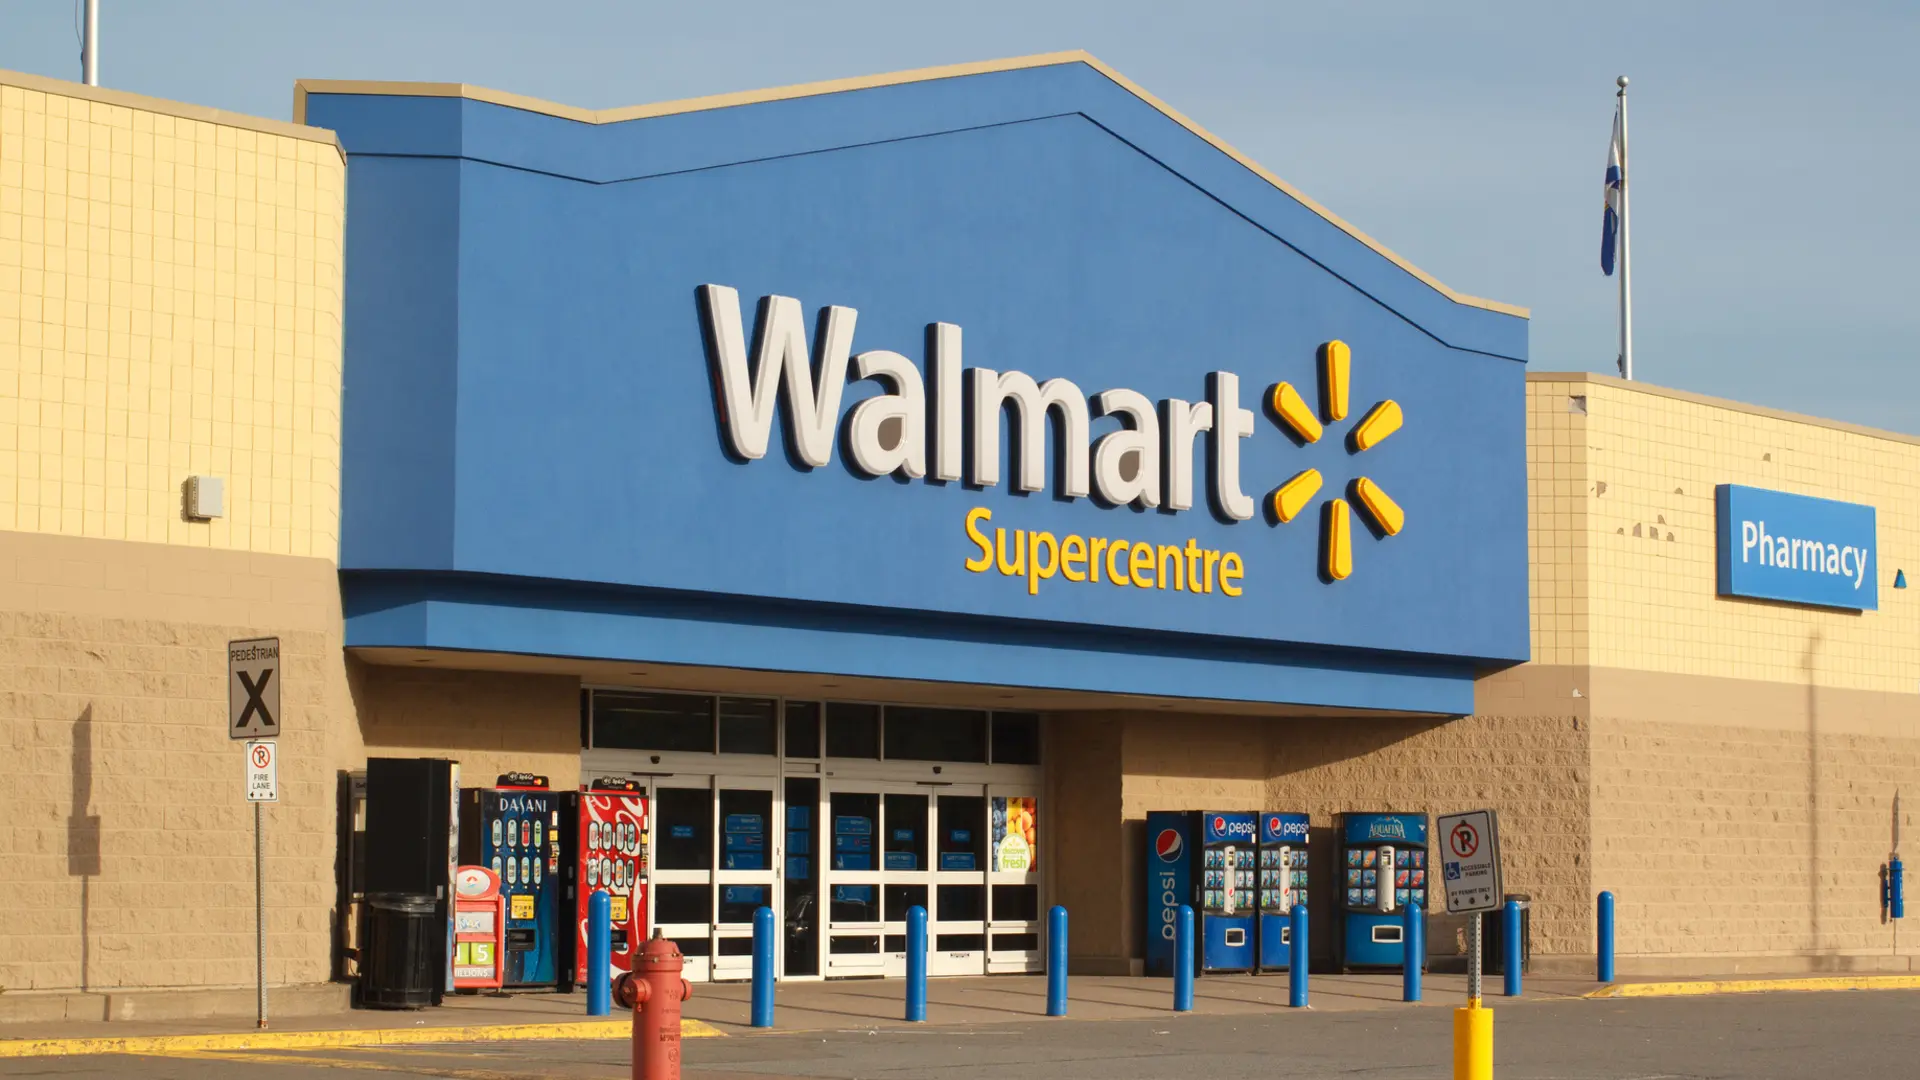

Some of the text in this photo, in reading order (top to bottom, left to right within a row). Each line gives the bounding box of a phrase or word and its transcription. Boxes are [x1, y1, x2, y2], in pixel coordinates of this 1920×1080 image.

[697, 283, 1255, 523] Walmart
[965, 507, 1244, 597] Supercentre
[1742, 520, 1867, 590] Pharmacy
[231, 646, 278, 662] PEDESTRIAN
[236, 668, 276, 728] X
[252, 781, 271, 790] LANE
[253, 773, 269, 782] FIRE
[500, 795, 546, 814] DASANI
[1229, 820, 1253, 836] pepsi
[1284, 820, 1306, 836] pepsi
[1368, 822, 1406, 838] AQUAFINA
[1003, 847, 1026, 855] discover
[1002, 856, 1027, 869] fresh
[1460, 863, 1491, 872] ACCESSIBLE
[1159, 870, 1179, 940] pepsi
